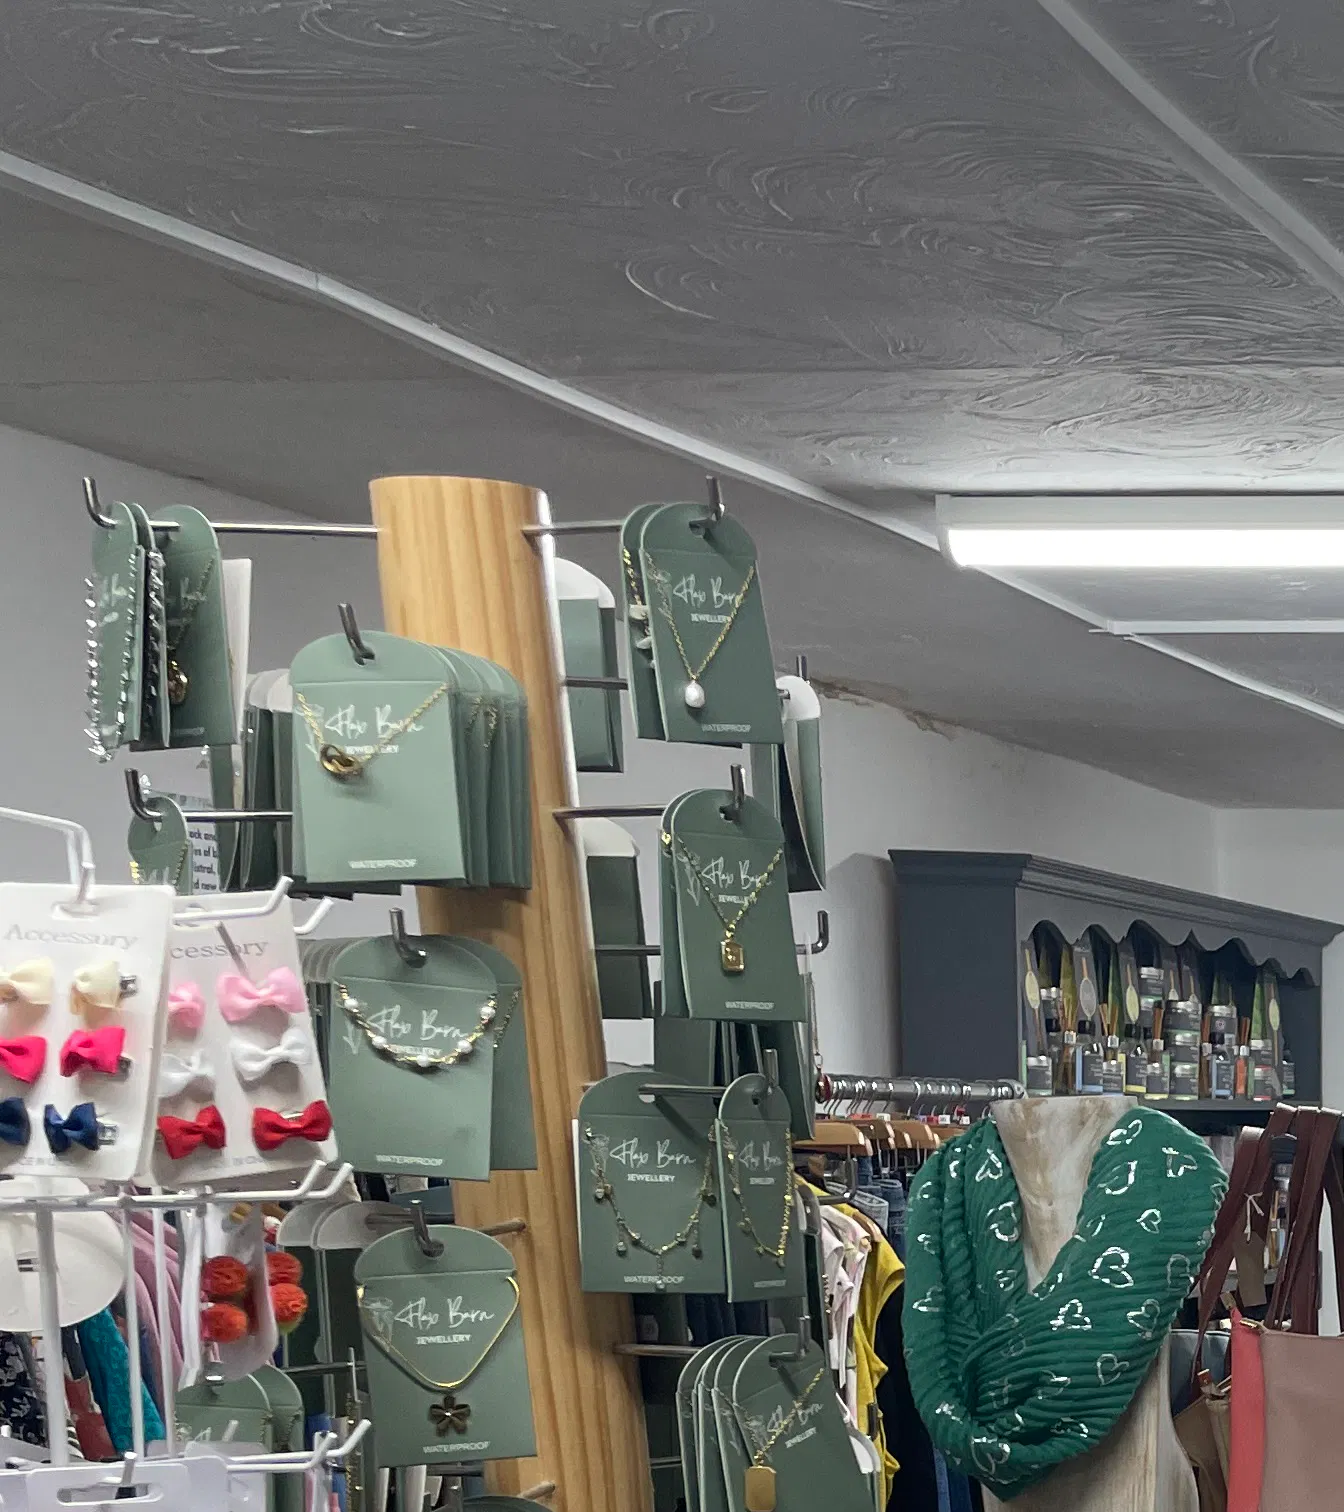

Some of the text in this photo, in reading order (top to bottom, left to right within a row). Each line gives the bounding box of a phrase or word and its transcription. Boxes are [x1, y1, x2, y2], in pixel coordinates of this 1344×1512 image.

[3, 923, 138, 949] Accessory
[627, 1173, 676, 1183] JEWELLERY
[447, 1295, 495, 1329] Barn
[416, 1333, 472, 1345] JEWELLERY
[422, 1440, 491, 1454] WATERPROOF
